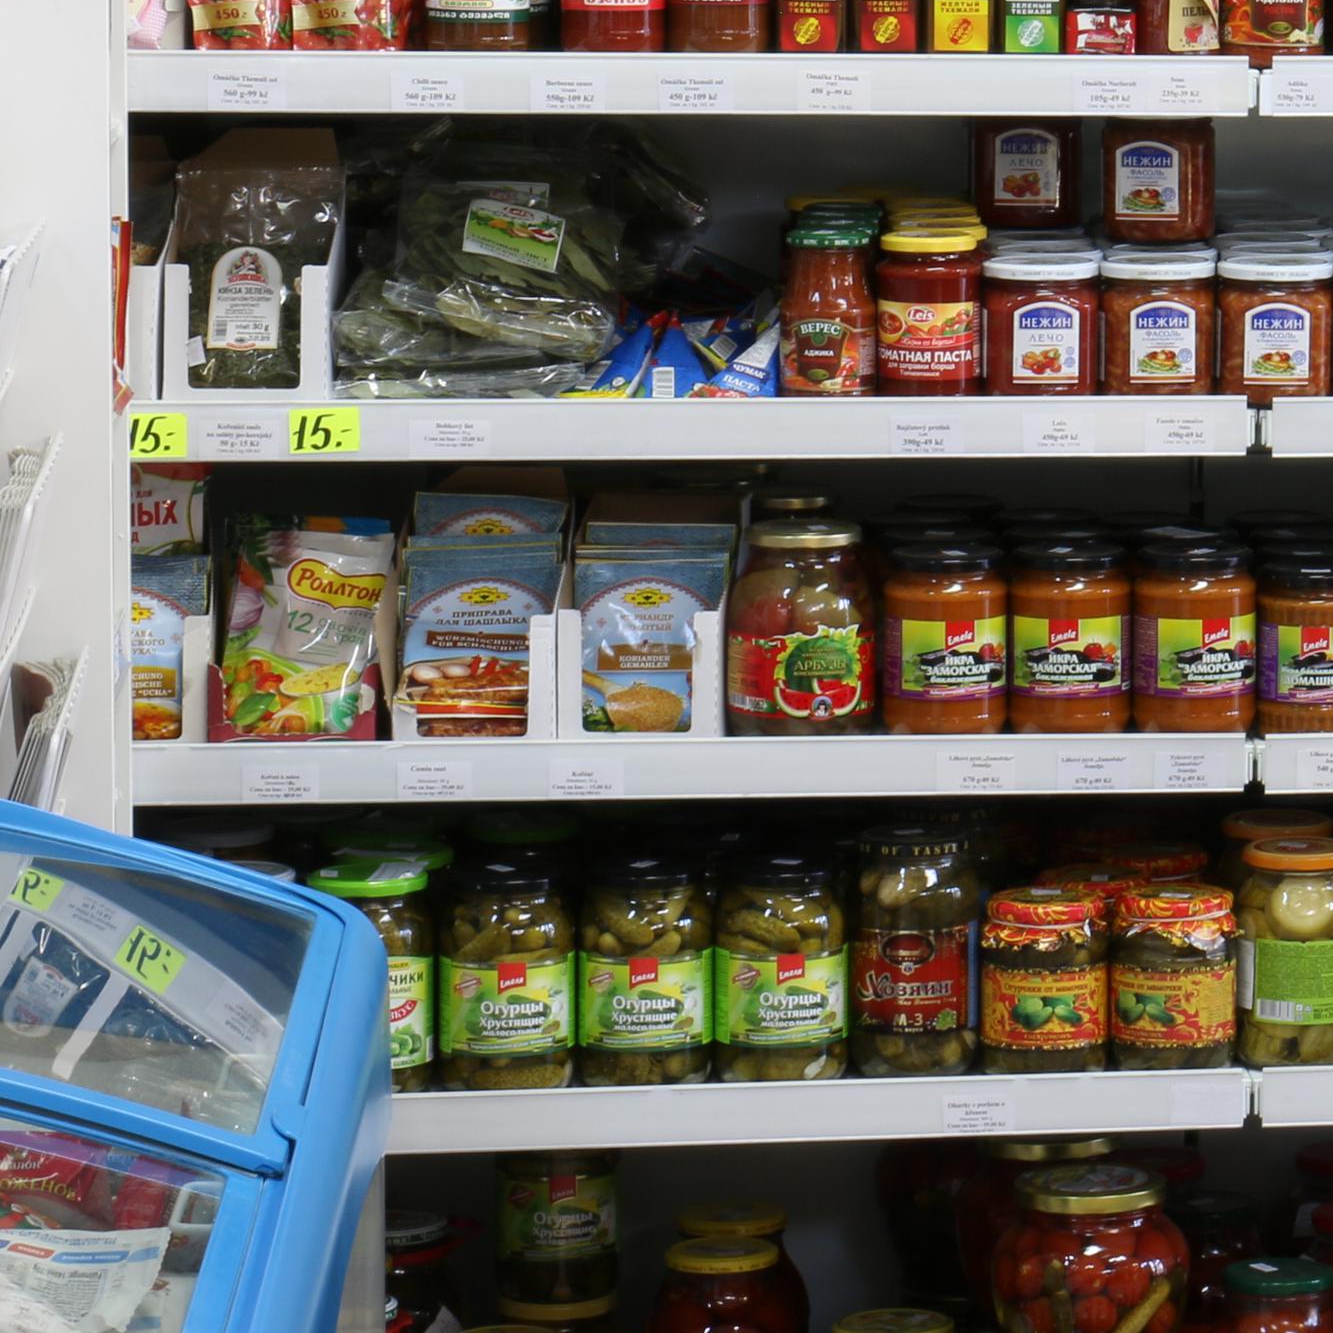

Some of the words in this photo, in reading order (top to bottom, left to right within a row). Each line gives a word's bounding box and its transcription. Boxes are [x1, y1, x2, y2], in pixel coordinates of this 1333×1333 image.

[317, 6, 339, 20] 450
[1123, 155, 1172, 167] НЕЖИН
[799, 322, 841, 336] ВЕРЕС
[1253, 317, 1303, 331] НЕЖИН
[929, 350, 972, 363] ПАСТА
[297, 567, 382, 603] Роллтон
[619, 655, 670, 666] KORIANDER
[619, 662, 669, 672] GEMAHLEN
[612, 995, 675, 1011] Огурцы
[611, 1008, 677, 1022] Хрустящие
